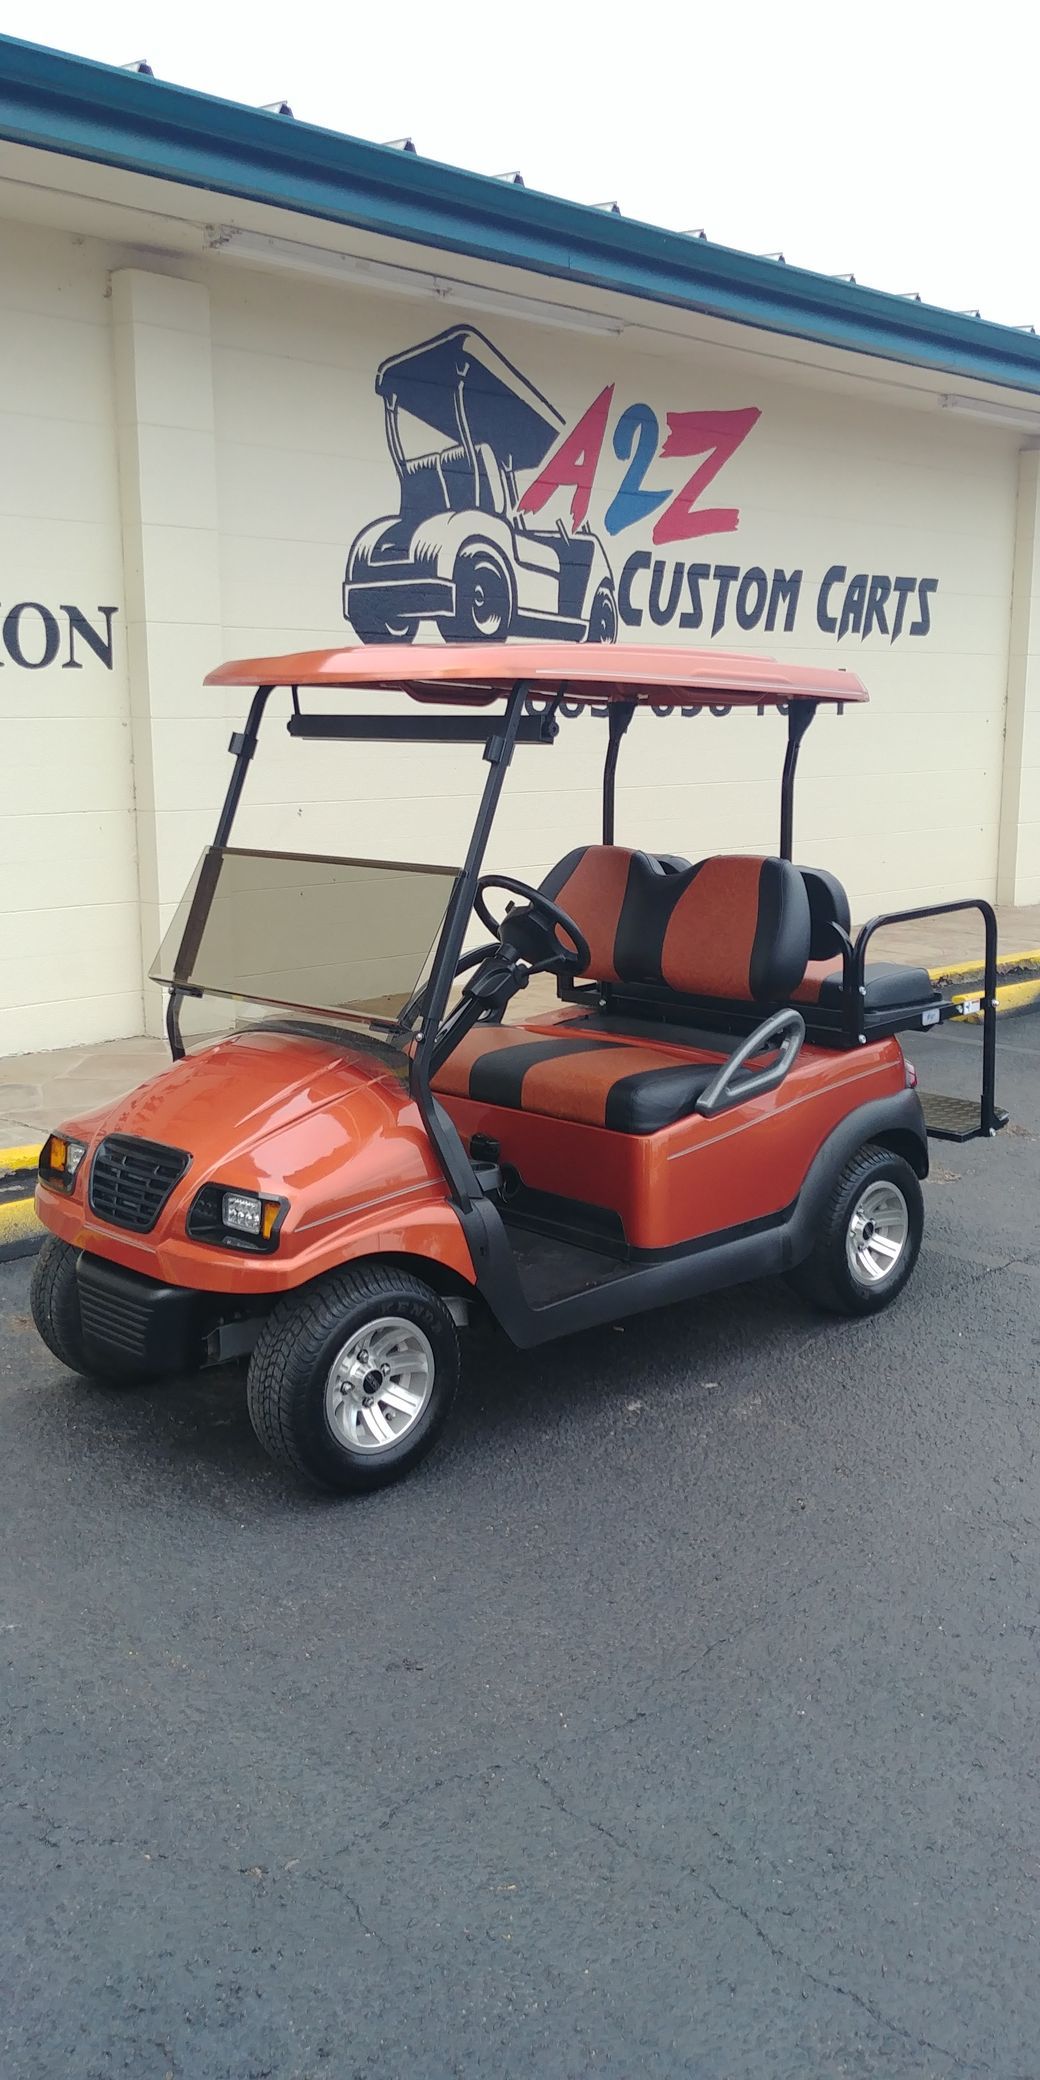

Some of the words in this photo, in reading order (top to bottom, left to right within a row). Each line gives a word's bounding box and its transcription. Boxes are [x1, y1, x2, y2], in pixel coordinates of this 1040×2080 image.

[517, 382, 762, 546] A2Z
[0, 601, 119, 670] ON
[618, 550, 803, 639] CUSTOM
[816, 565, 939, 645] CARTS
